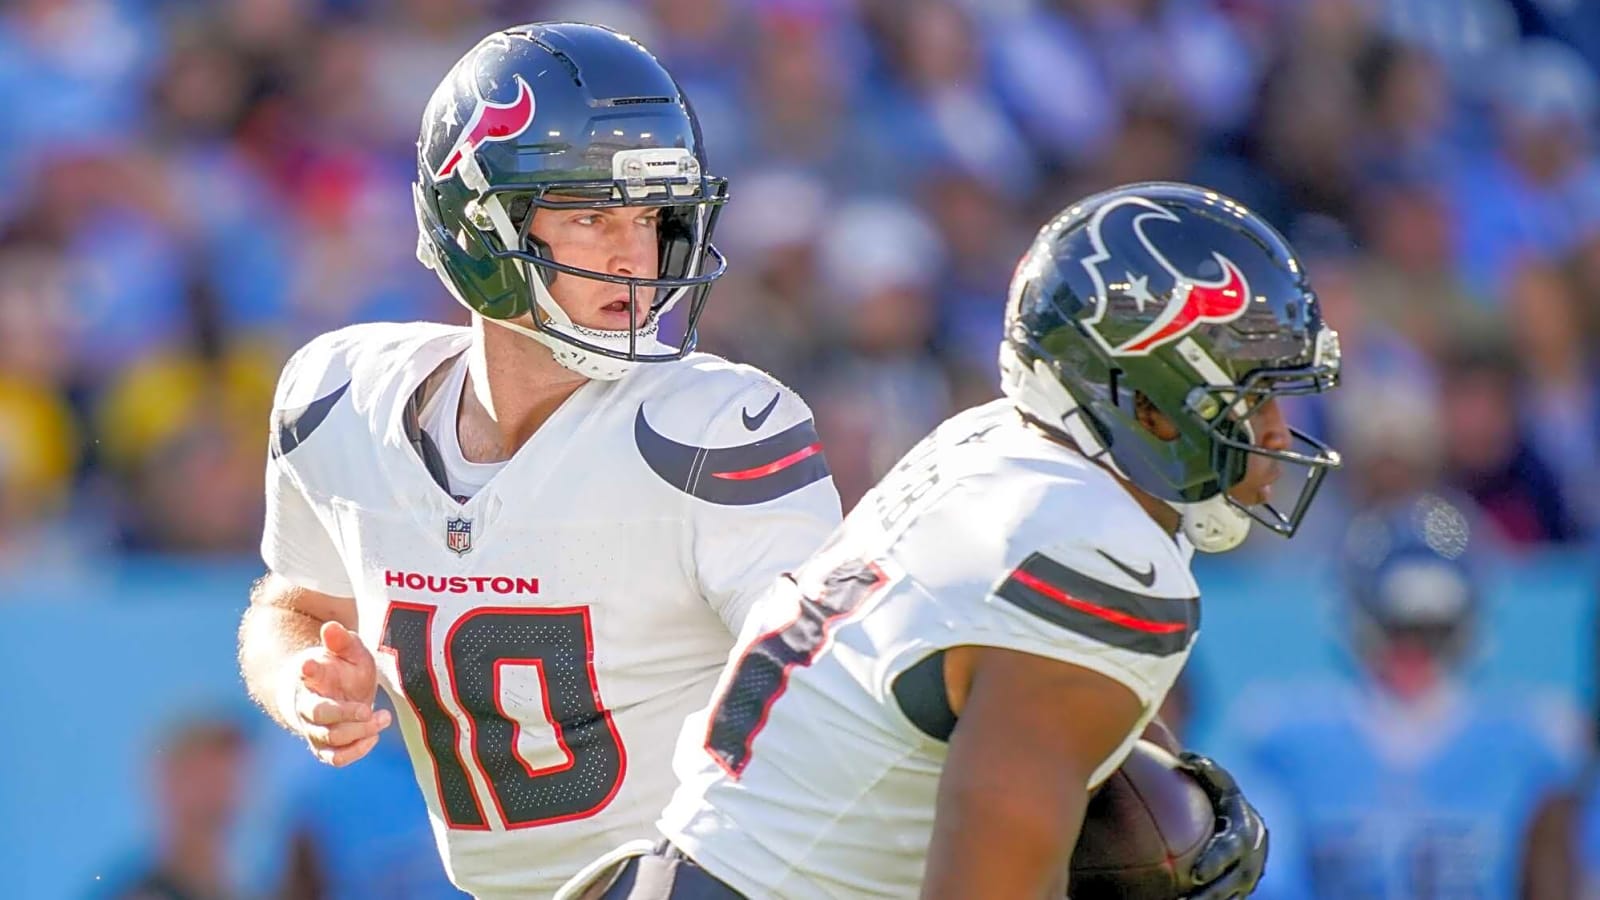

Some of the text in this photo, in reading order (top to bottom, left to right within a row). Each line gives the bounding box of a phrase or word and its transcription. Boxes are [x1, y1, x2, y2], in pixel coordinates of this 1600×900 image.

[449, 532, 469, 549] NFL
[385, 570, 539, 594] HOUSTON
[378, 600, 627, 831] 10
